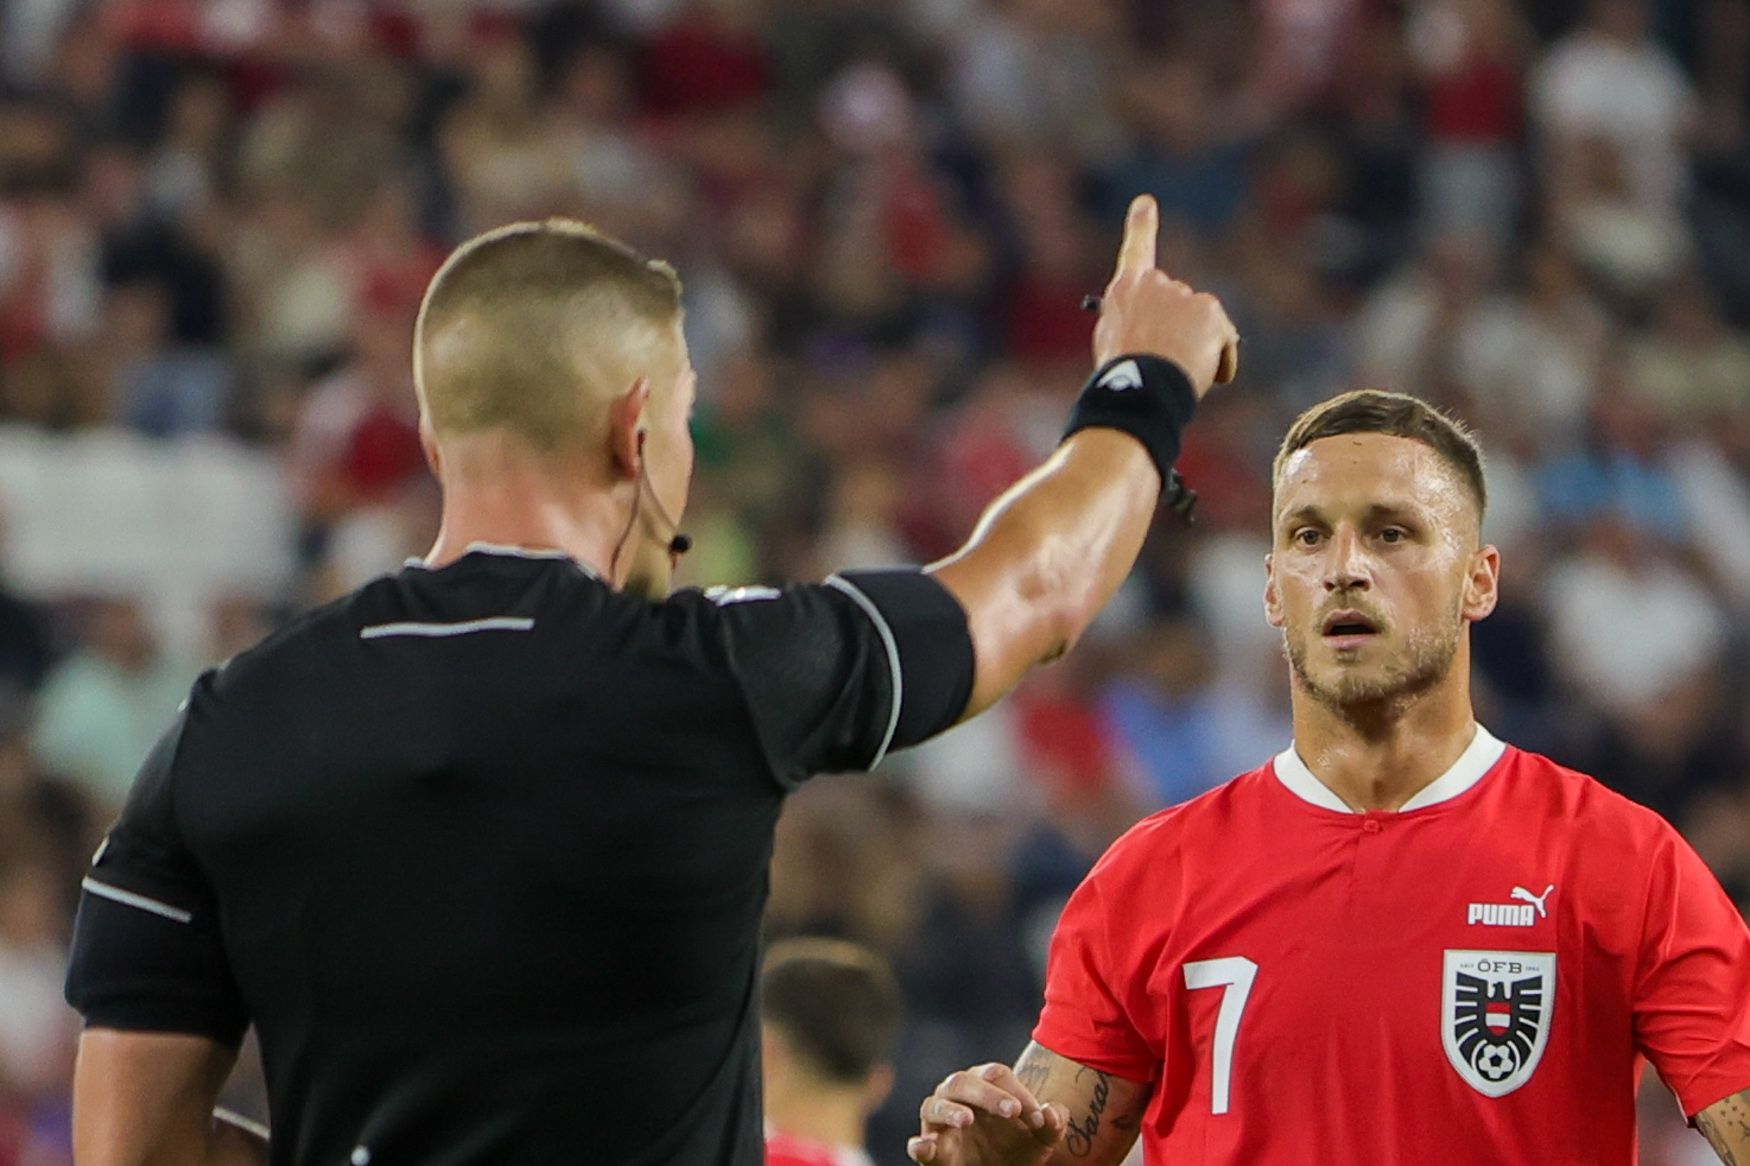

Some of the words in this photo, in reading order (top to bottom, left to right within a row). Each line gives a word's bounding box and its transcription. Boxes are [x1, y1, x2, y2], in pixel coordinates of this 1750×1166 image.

[1468, 903, 1535, 926] PUMA
[1477, 958, 1523, 974] ÖFB
[1182, 955, 1258, 1115] 7
